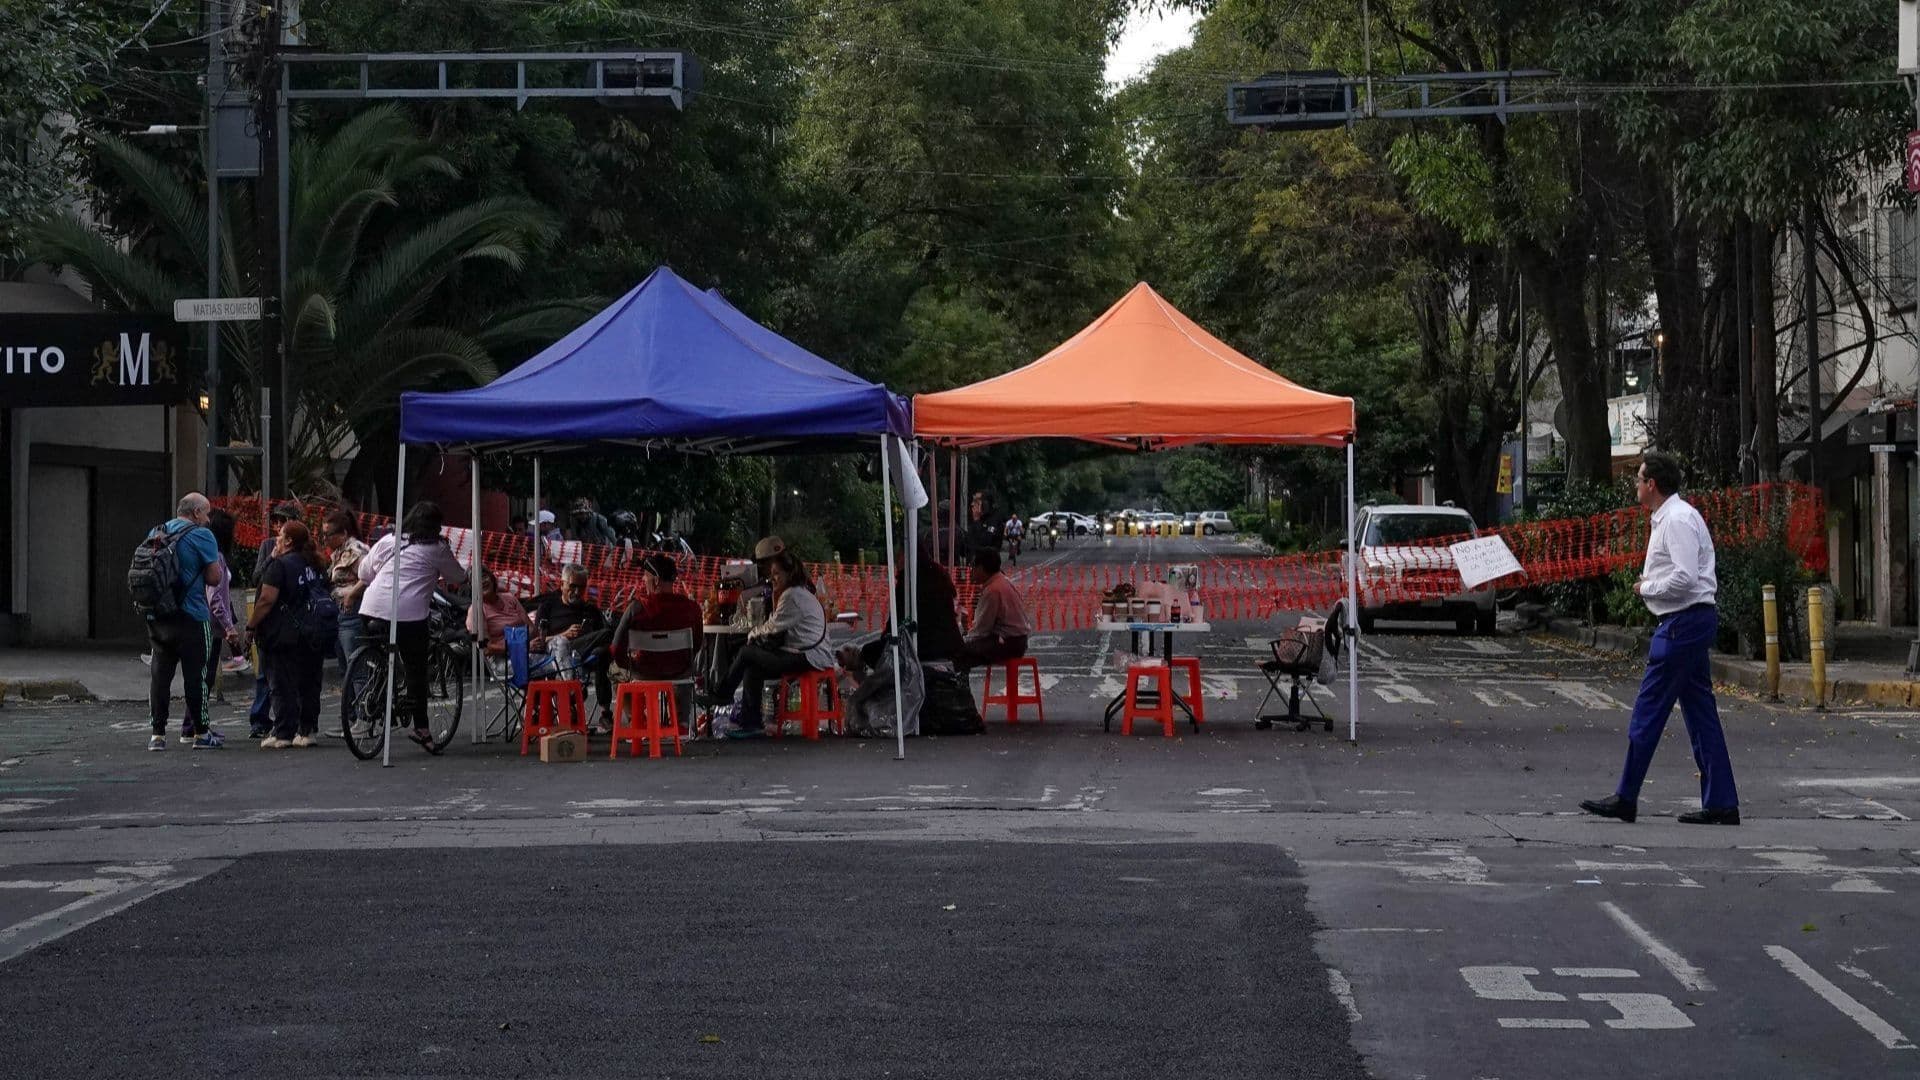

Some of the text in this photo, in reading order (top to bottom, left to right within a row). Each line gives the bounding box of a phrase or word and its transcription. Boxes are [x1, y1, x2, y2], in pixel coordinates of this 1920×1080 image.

[193, 302, 259, 316] MATIAS ROMERO
[0, 346, 65, 374] ITO
[119, 332, 151, 386] M
[1454, 544, 1471, 554] NO
